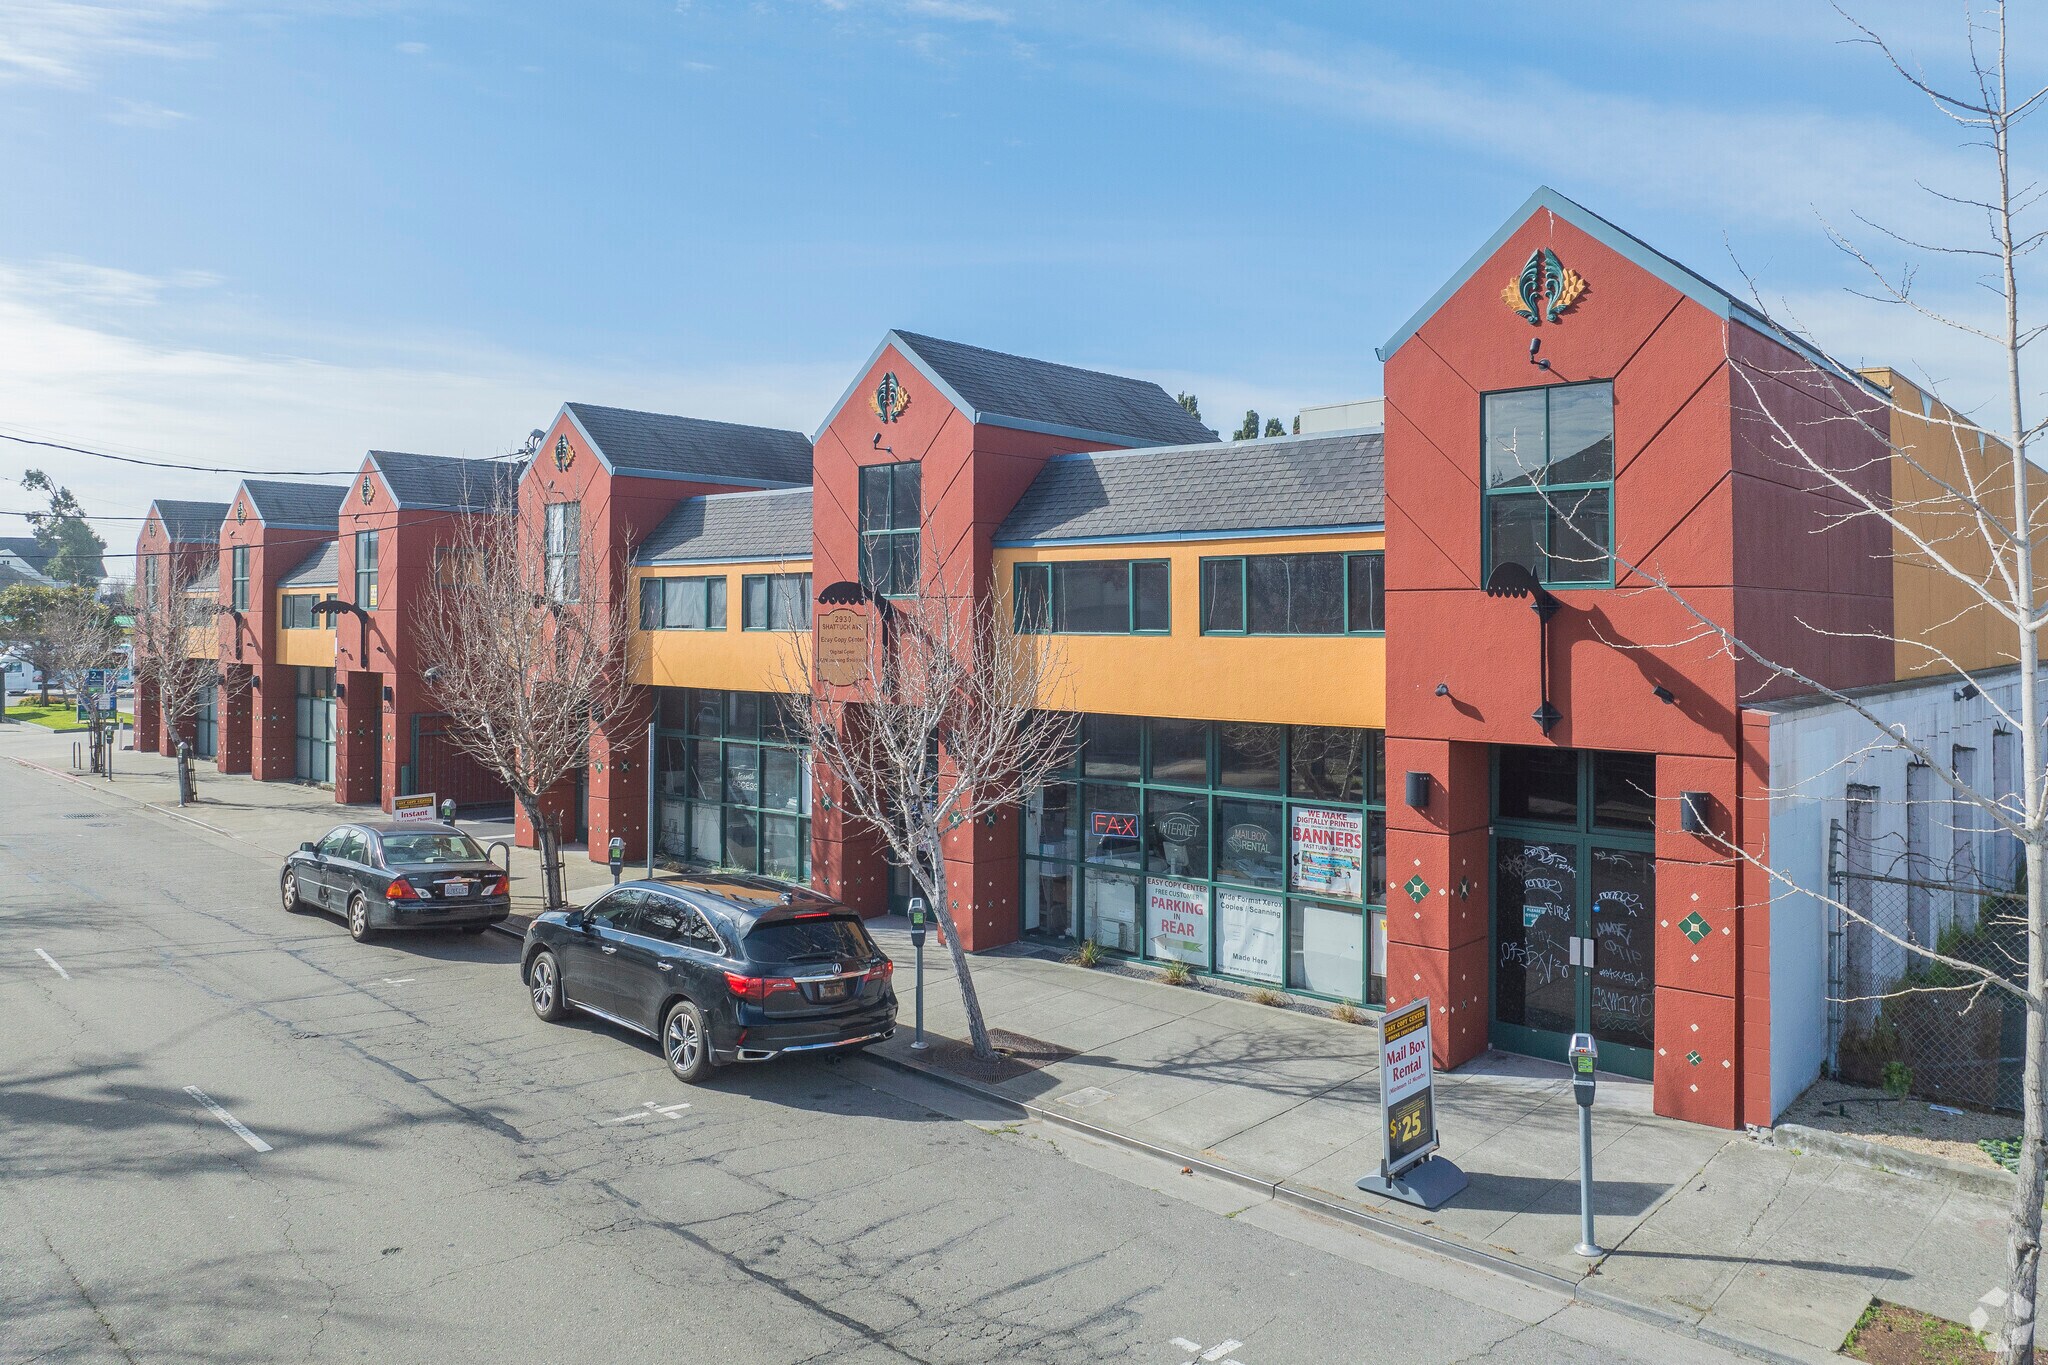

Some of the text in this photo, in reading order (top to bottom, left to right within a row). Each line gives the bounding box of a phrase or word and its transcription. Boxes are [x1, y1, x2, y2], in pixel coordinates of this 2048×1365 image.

[835, 615, 852, 623] 2930
[820, 636, 833, 644] Easy
[834, 636, 847, 644] Copy
[401, 810, 428, 818] Instant
[1307, 810, 1348, 821] WE MAKE
[1095, 815, 1135, 836] FAX
[1158, 821, 1200, 838] INTERNET
[1296, 816, 1329, 826] DIGITALLY
[1329, 820, 1359, 829] PRINTED
[1233, 829, 1267, 842] MAILBOX
[1293, 827, 1362, 849] BANNERS
[1241, 840, 1271, 854] RENTAL
[1332, 846, 1354, 854] AROUND
[1147, 878, 1208, 893] EASY COPY CENTER
[1155, 888, 1200, 900] FREE CUSTOMER
[1219, 892, 1283, 909] Wide Format Xerox
[1151, 896, 1204, 916] PARKING
[1220, 901, 1244, 912] Copies
[1249, 905, 1281, 919] Scanning
[1173, 913, 1181, 921] IN
[1161, 919, 1195, 937] REAR
[1232, 952, 1268, 965] Made Here
[1386, 1040, 1426, 1068] Mail Box
[1392, 1056, 1422, 1082] Rental
